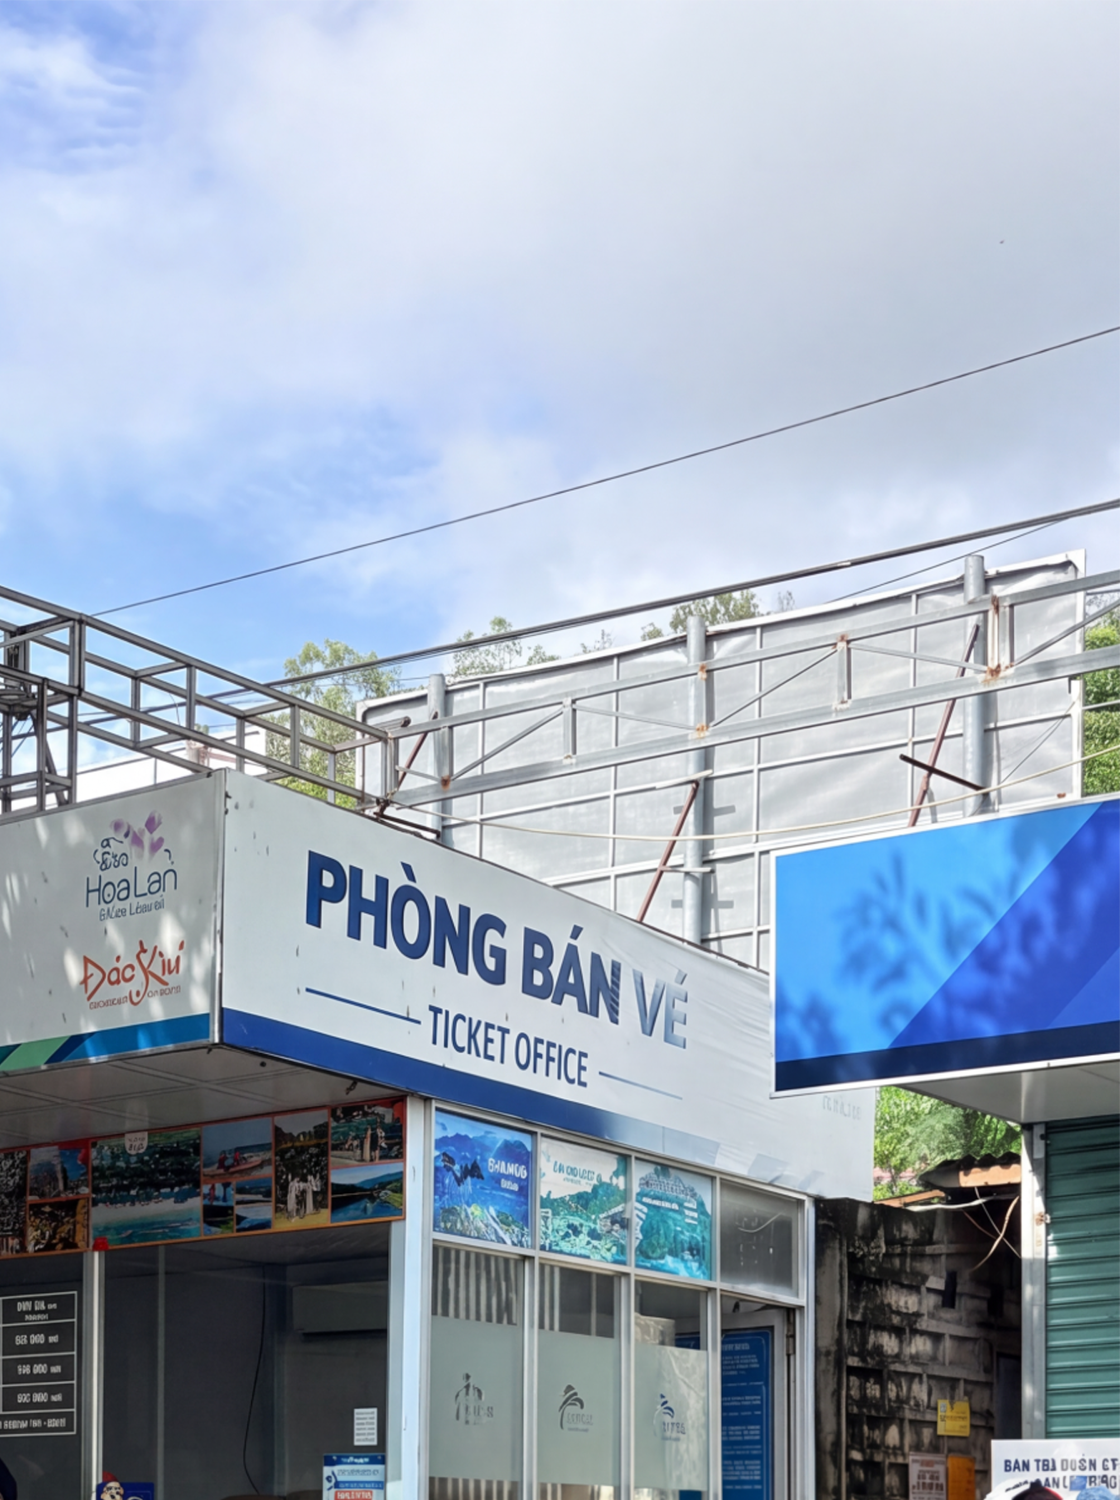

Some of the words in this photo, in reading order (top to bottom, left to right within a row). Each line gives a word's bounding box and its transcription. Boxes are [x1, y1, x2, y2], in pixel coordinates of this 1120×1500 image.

[305, 849, 507, 987] PHÒNG
[521, 924, 622, 1025] BÁN
[632, 967, 689, 1050] VÉ
[427, 1004, 510, 1066] TICKET
[513, 1032, 589, 1089] OFFICE
